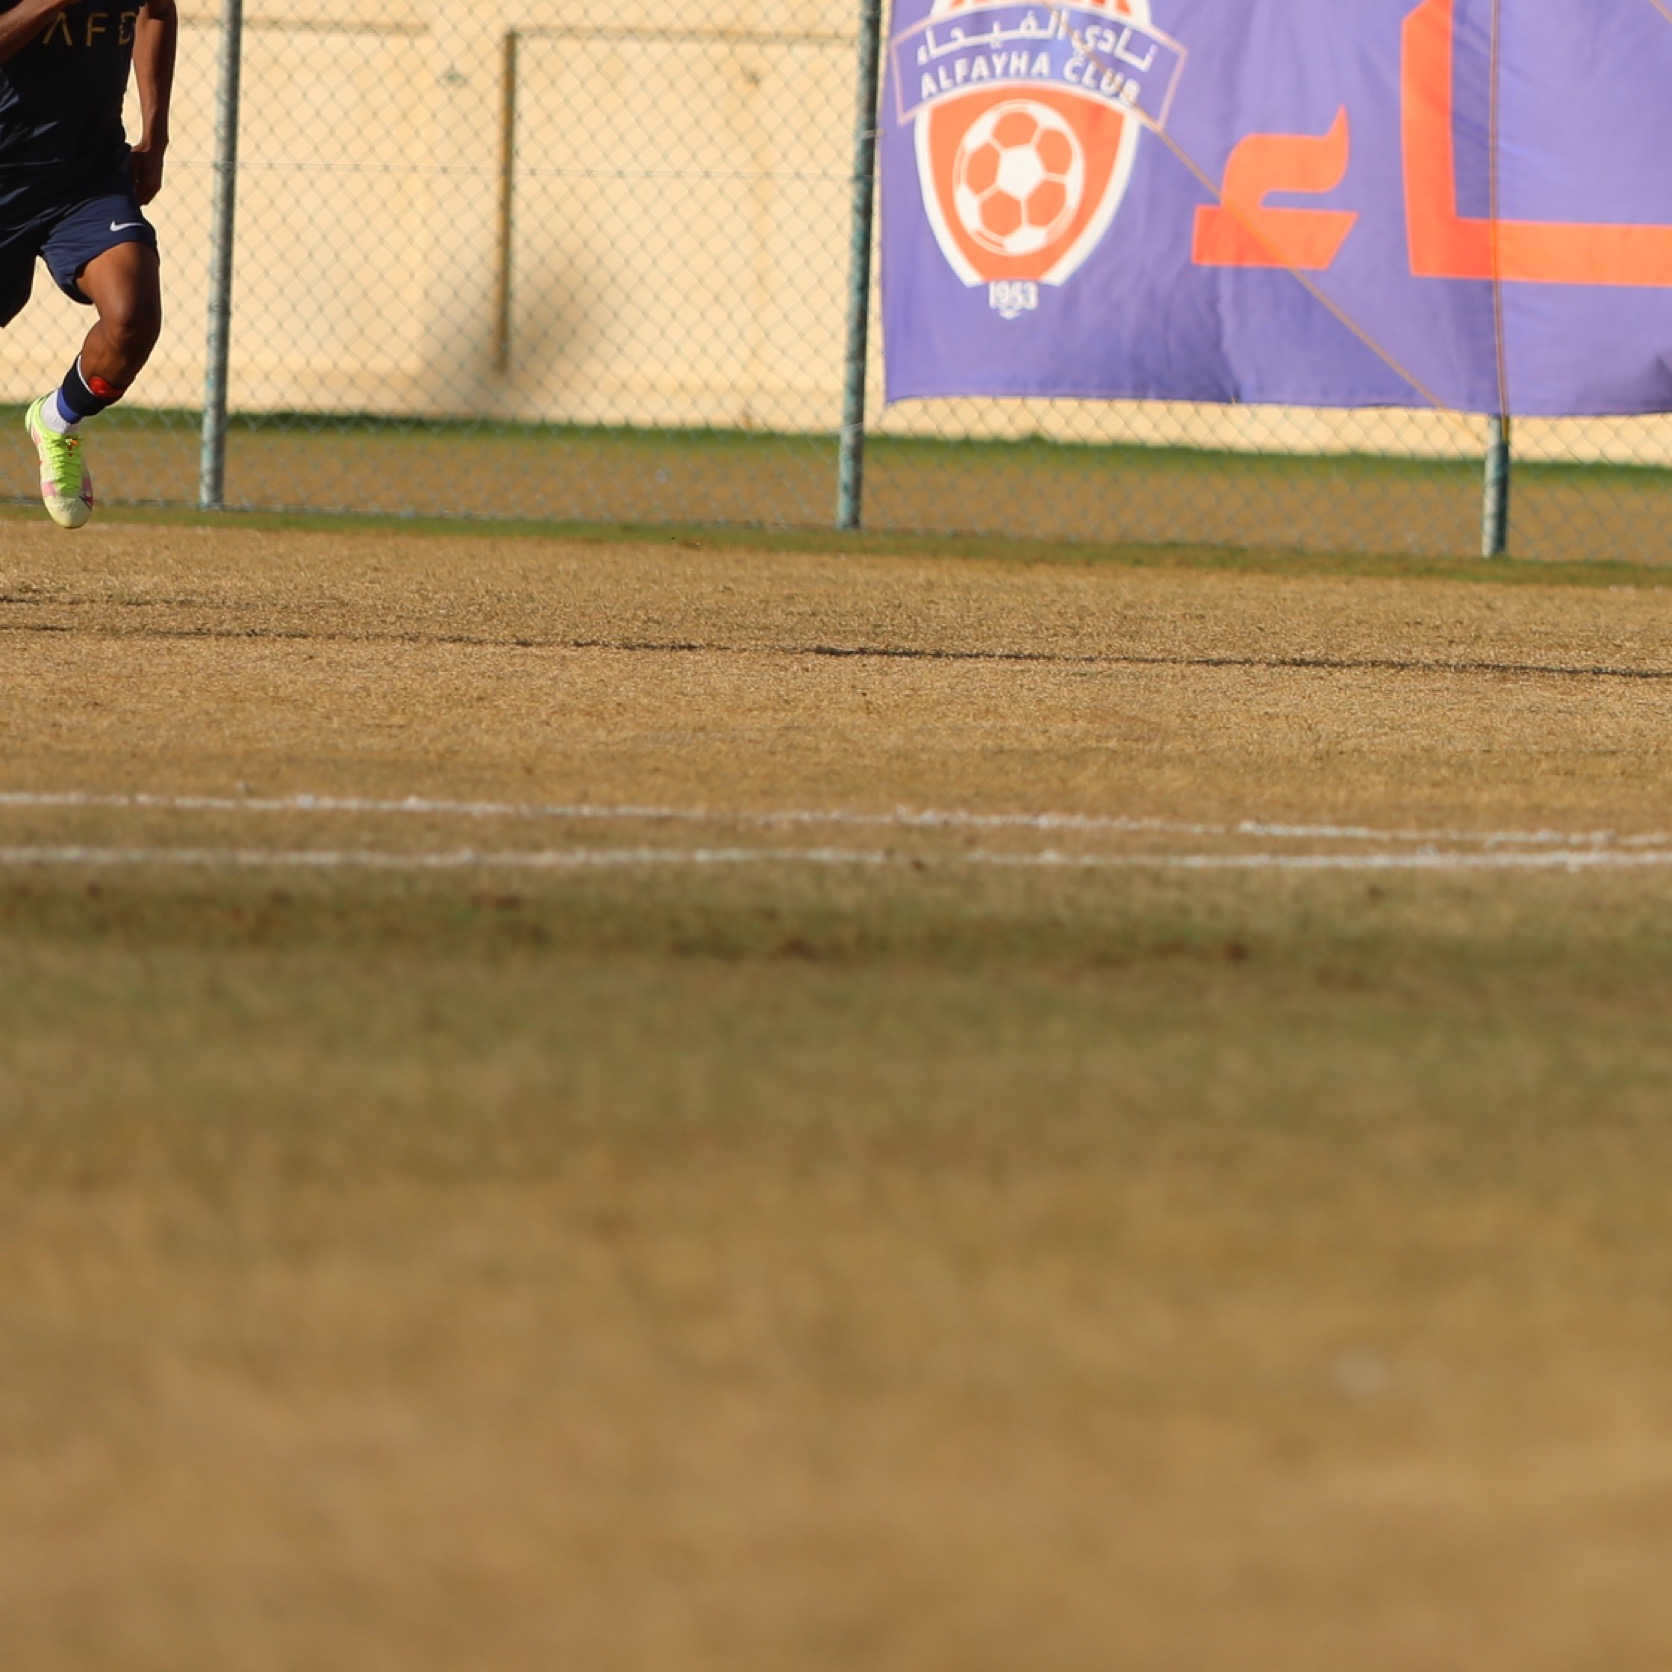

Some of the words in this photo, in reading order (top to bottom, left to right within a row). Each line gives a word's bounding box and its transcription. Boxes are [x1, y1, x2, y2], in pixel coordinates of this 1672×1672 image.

[42, 11, 137, 47] AFD
[920, 51, 1051, 100] ALFAYHA
[1062, 57, 1142, 108] CLUB
